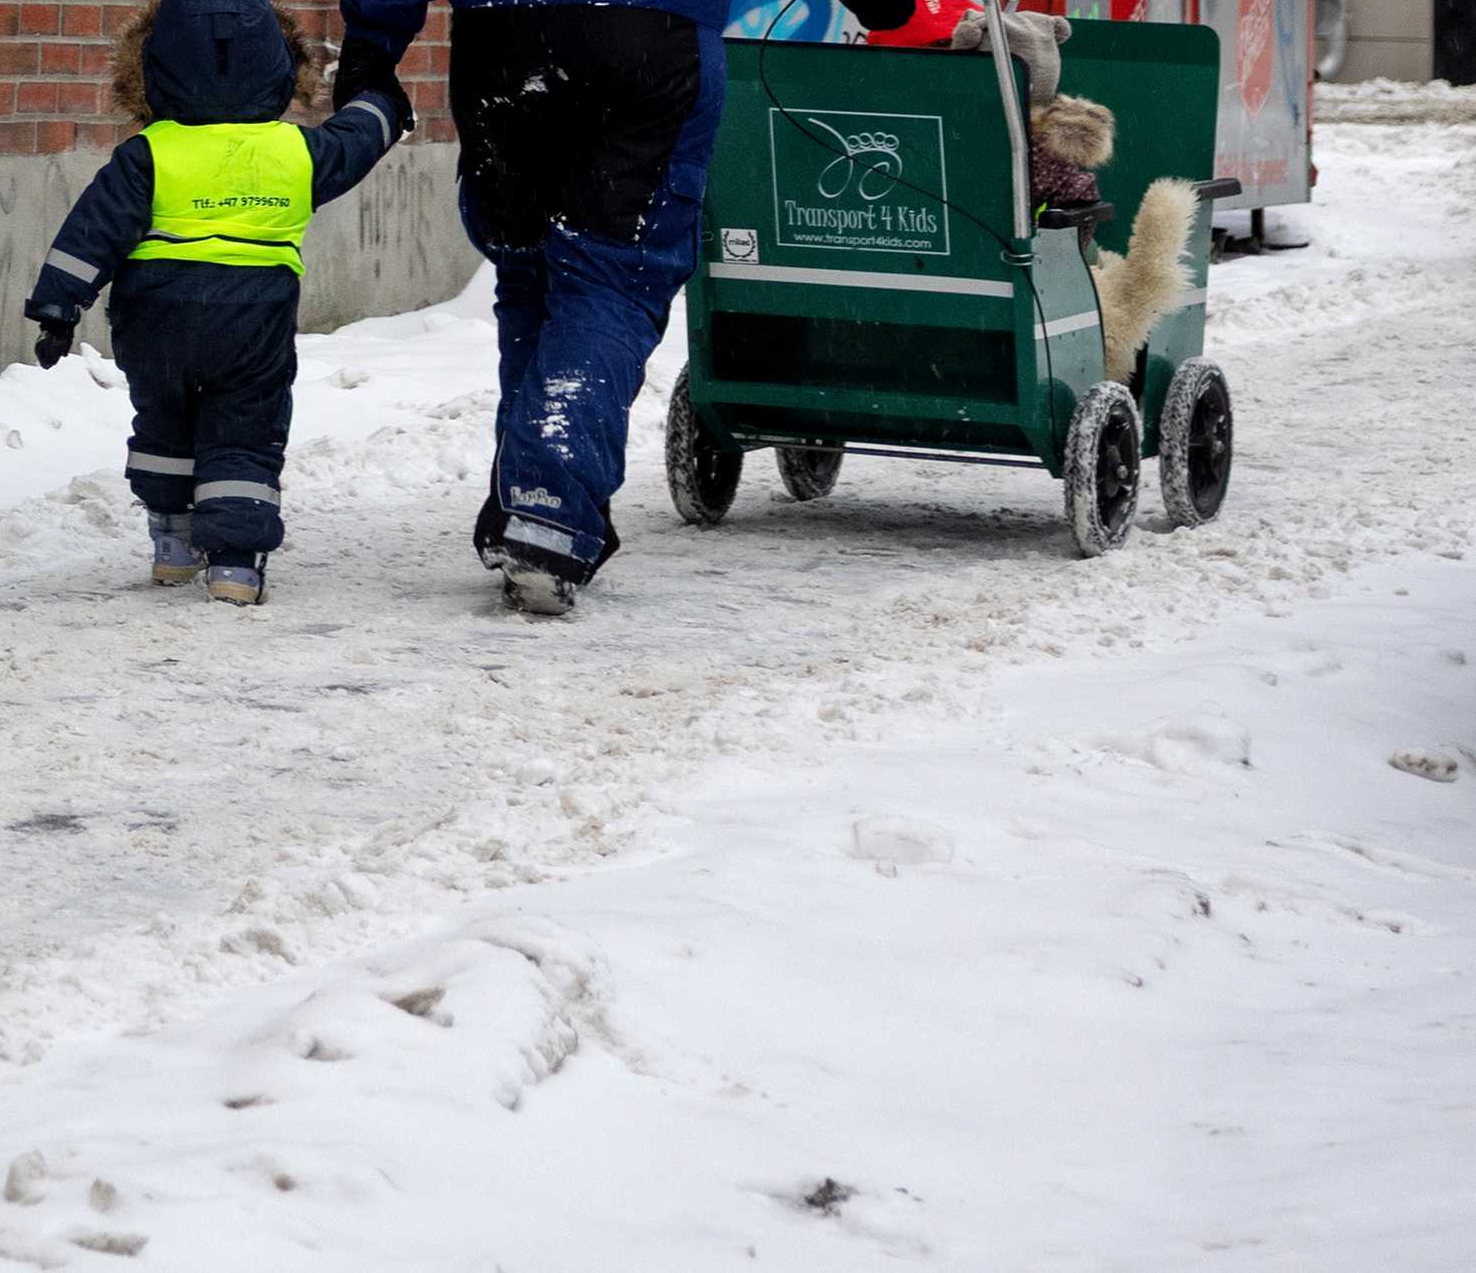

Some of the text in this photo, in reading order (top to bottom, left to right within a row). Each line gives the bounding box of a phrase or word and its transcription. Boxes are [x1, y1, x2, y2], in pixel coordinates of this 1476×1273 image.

[785, 199, 938, 235] Transport 4 Kids
[793, 232, 932, 249] www.transport4kids.com
